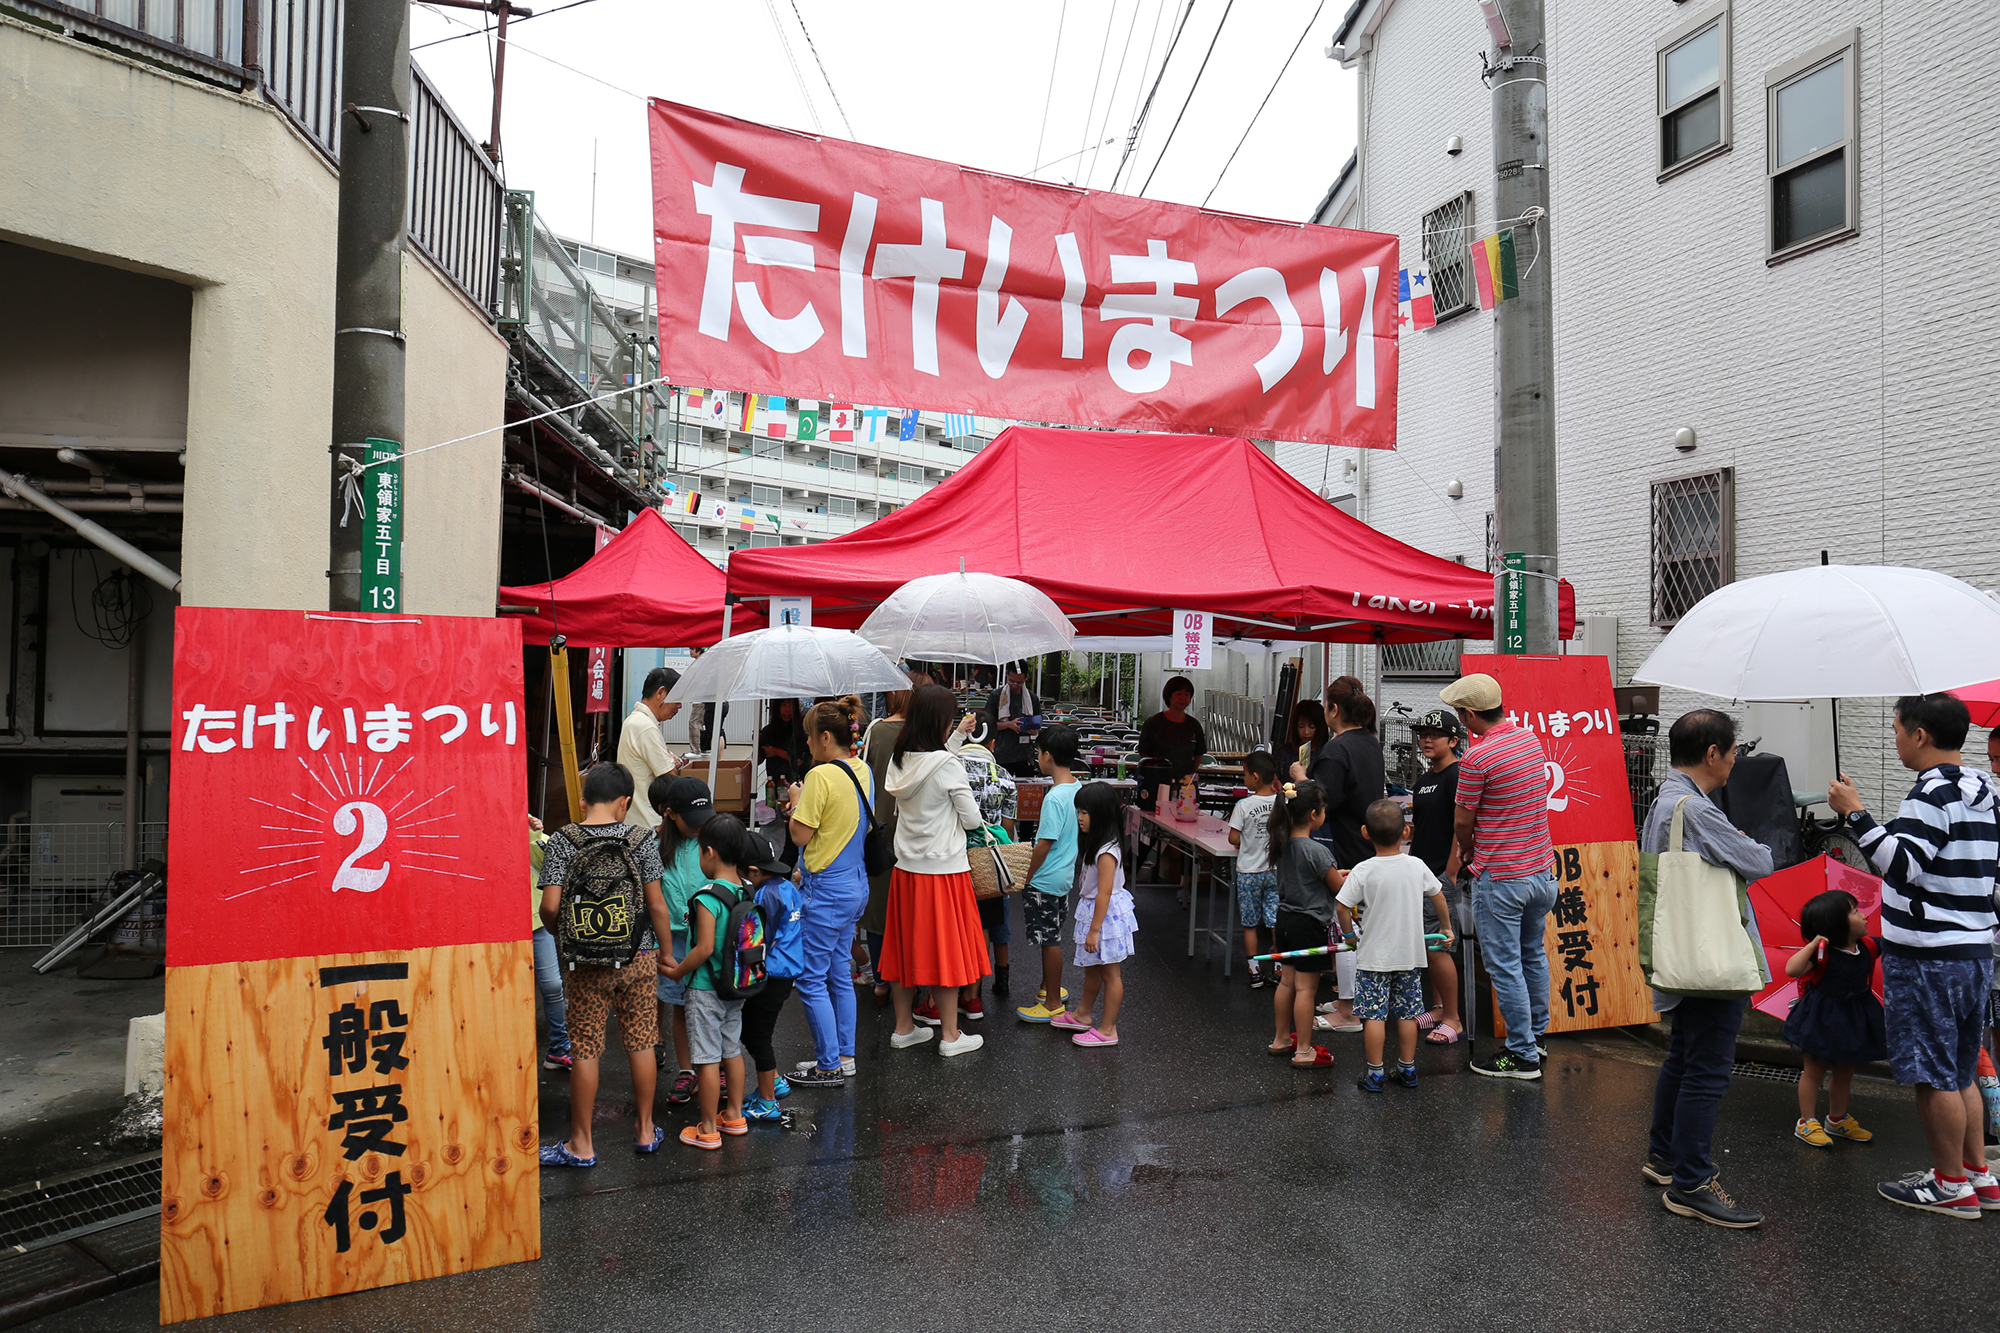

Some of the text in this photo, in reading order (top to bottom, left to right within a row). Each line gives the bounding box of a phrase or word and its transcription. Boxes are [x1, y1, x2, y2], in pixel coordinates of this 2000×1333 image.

[692, 161, 1380, 410] たけいまつり
[375, 472, 393, 575] 東領家五丁目
[369, 586, 396, 610] 13
[1508, 571, 1519, 629] 東領家五丁目
[1507, 635, 1522, 648] 12
[181, 700, 518, 753] たけいまつり
[1418, 784, 1438, 795] ROXY
[331, 801, 391, 893] 2
[319, 961, 411, 1254] 一般受付
